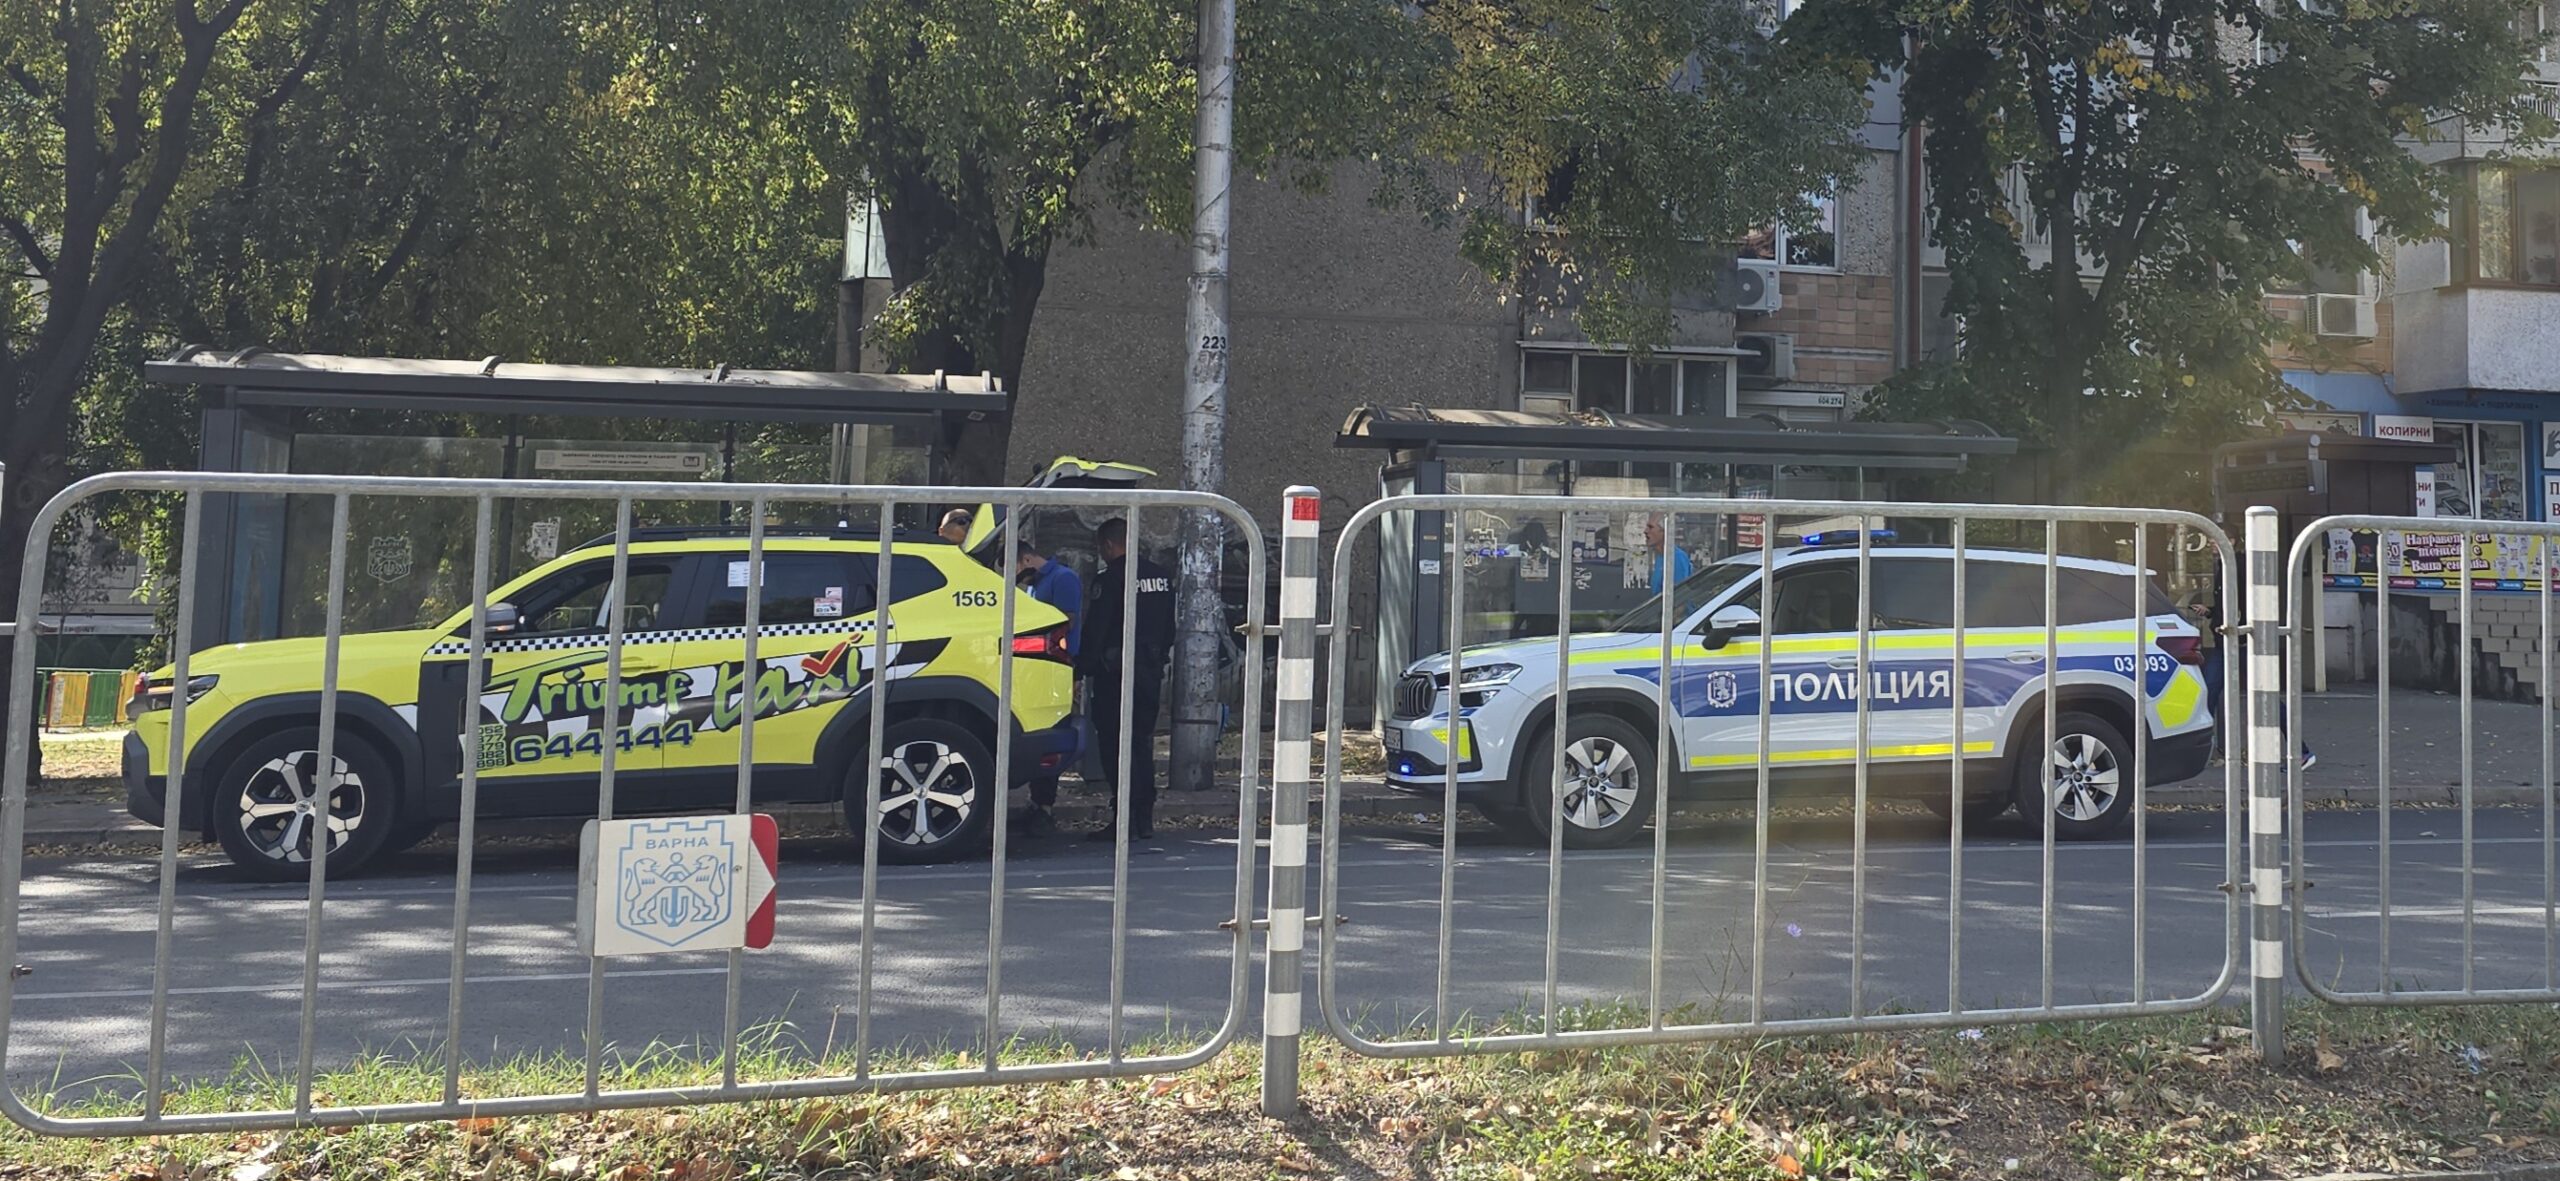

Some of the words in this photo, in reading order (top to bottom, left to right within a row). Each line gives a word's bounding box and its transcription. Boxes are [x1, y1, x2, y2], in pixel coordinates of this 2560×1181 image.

[1202, 335, 1226, 349] 223
[2379, 425, 2431, 438] КОПИРНИ
[2416, 482, 2432, 492] НИ
[1136, 577, 1169, 593] POLICE
[952, 591, 998, 607] 1563
[482, 650, 693, 725] Triumf
[713, 633, 864, 732] taxi
[1770, 670, 1950, 704] ПОЛИЦИЯ
[512, 720, 694, 764] 644444
[476, 758, 506, 768] 898
[645, 836, 709, 850] ВАРНА
